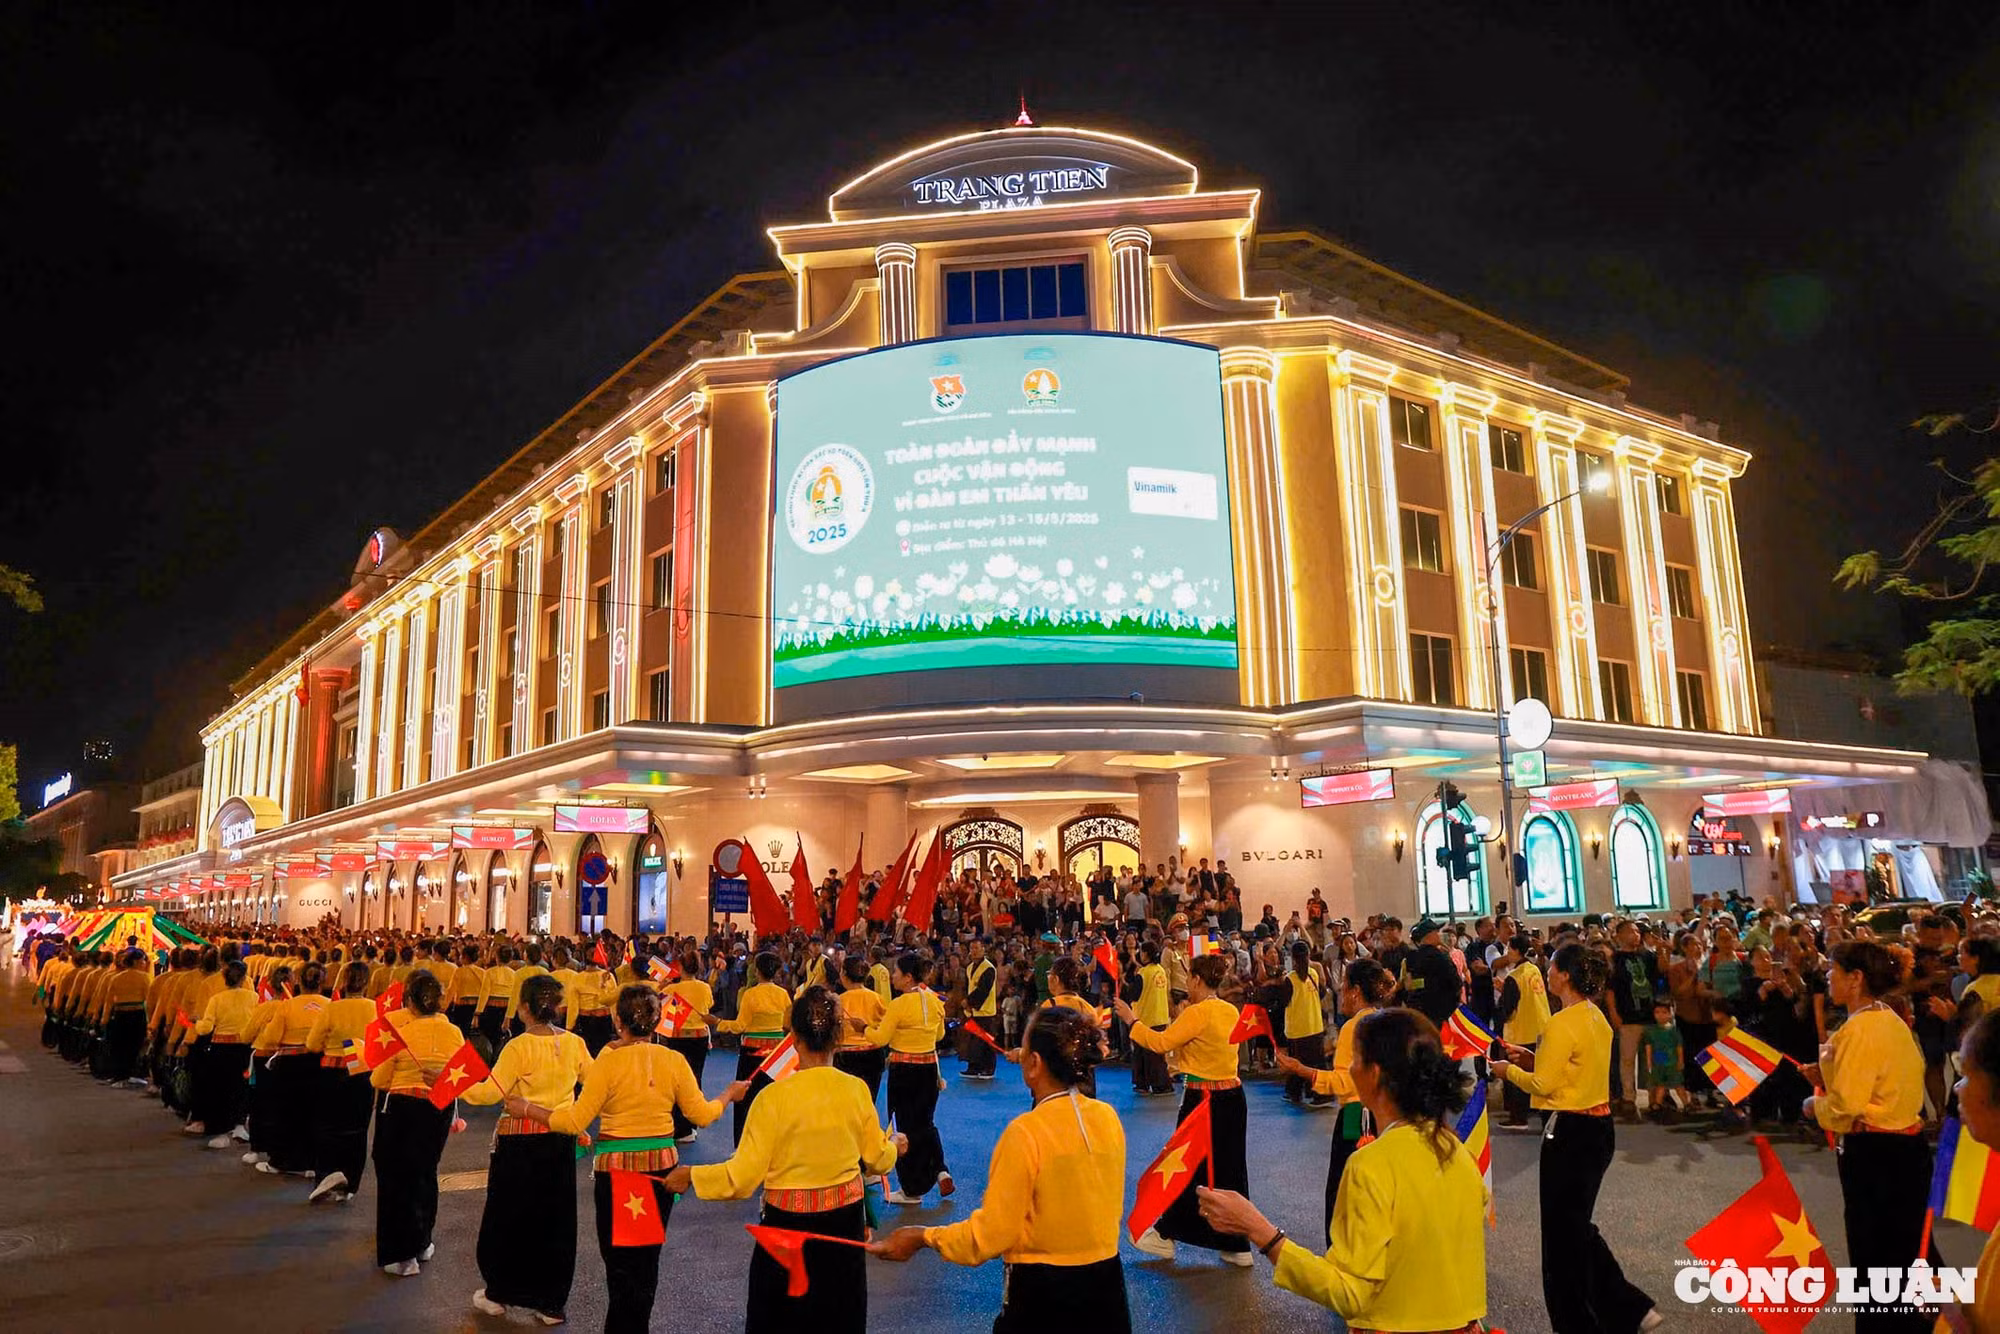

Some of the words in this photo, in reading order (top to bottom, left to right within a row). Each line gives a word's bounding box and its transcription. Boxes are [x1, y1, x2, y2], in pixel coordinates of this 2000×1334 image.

[914, 174, 1024, 205] TRANG
[1029, 167, 1109, 194] TIEN
[979, 196, 1043, 211] PLAZA
[1134, 481, 1178, 494] Vinamilk
[808, 523, 847, 544] 2025
[1552, 791, 1595, 802] MONTBLANC
[589, 815, 617, 824] ROLEX
[1241, 848, 1323, 862] BVLGARI
[760, 861, 790, 874] OLE
[299, 899, 332, 907] GUCCI
